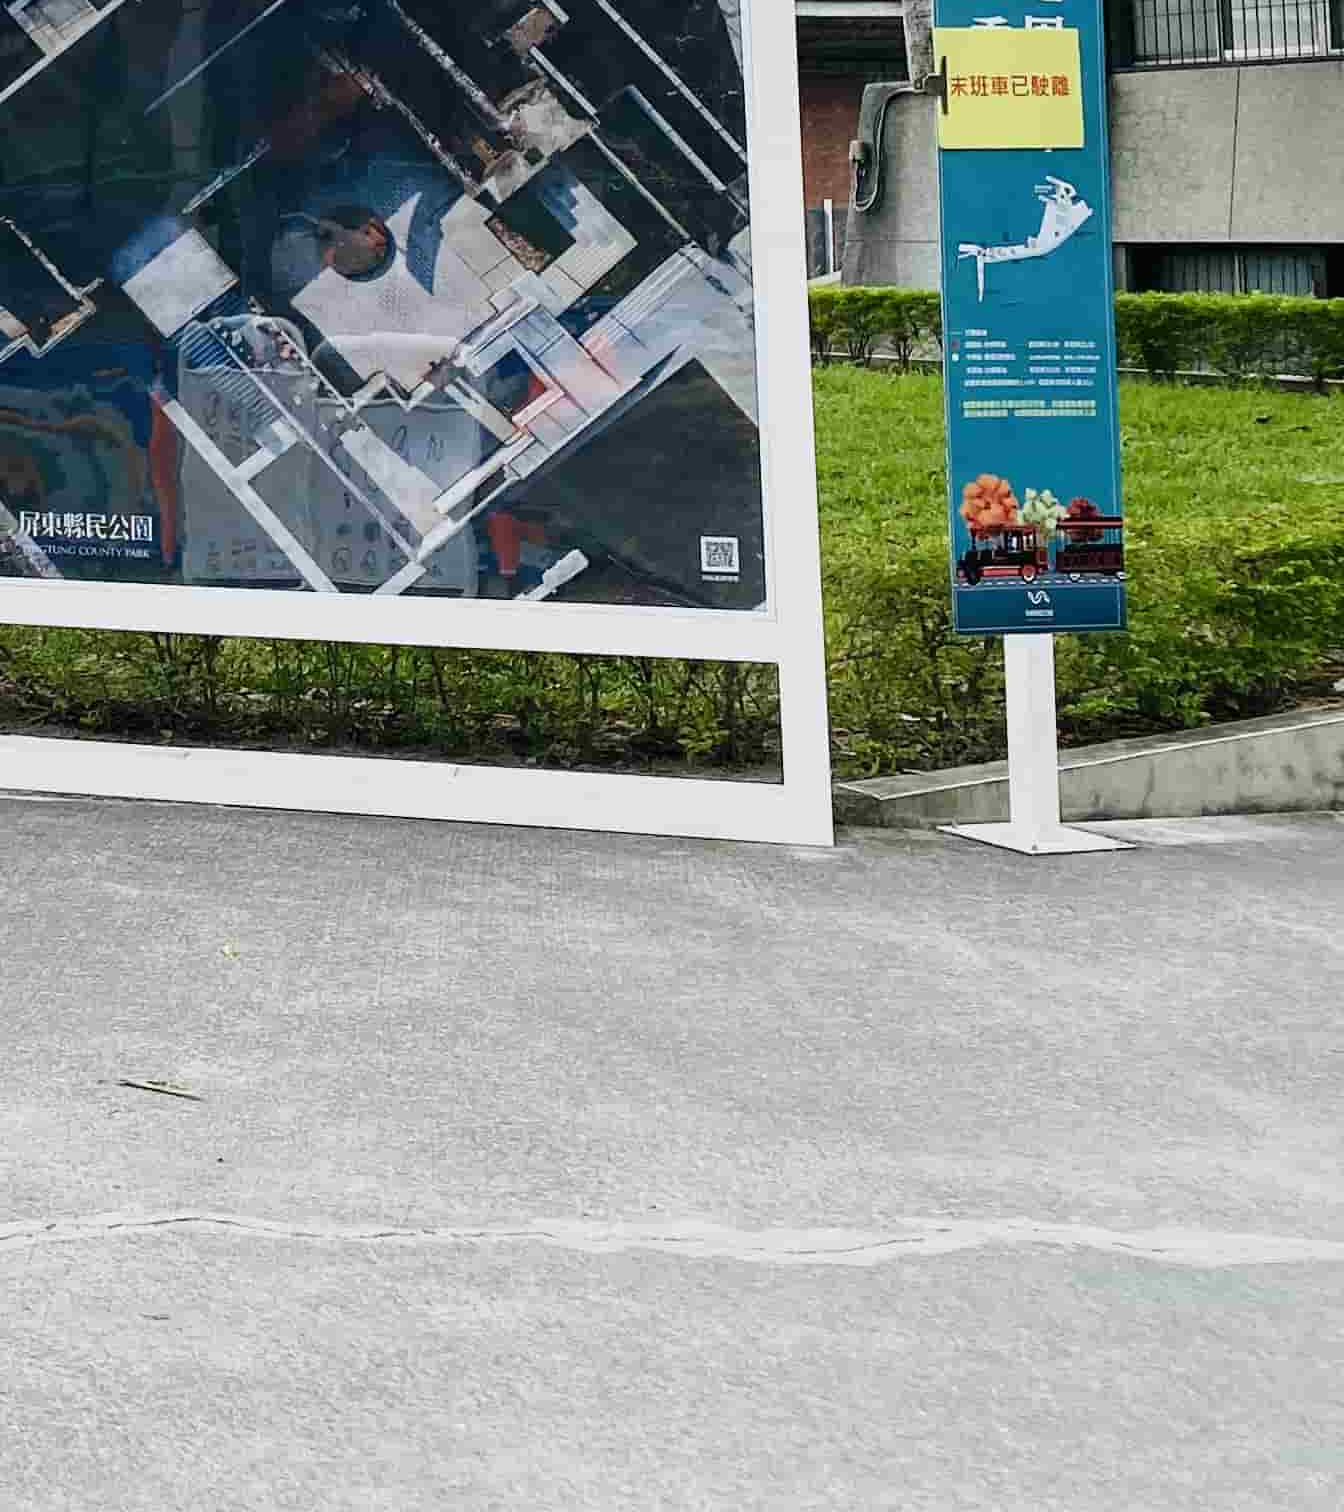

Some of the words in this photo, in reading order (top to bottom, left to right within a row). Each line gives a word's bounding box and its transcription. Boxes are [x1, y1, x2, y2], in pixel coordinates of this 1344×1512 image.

[950, 74, 1070, 96] 末班車已駛離
[18, 510, 153, 542] 屏東縣民公園
